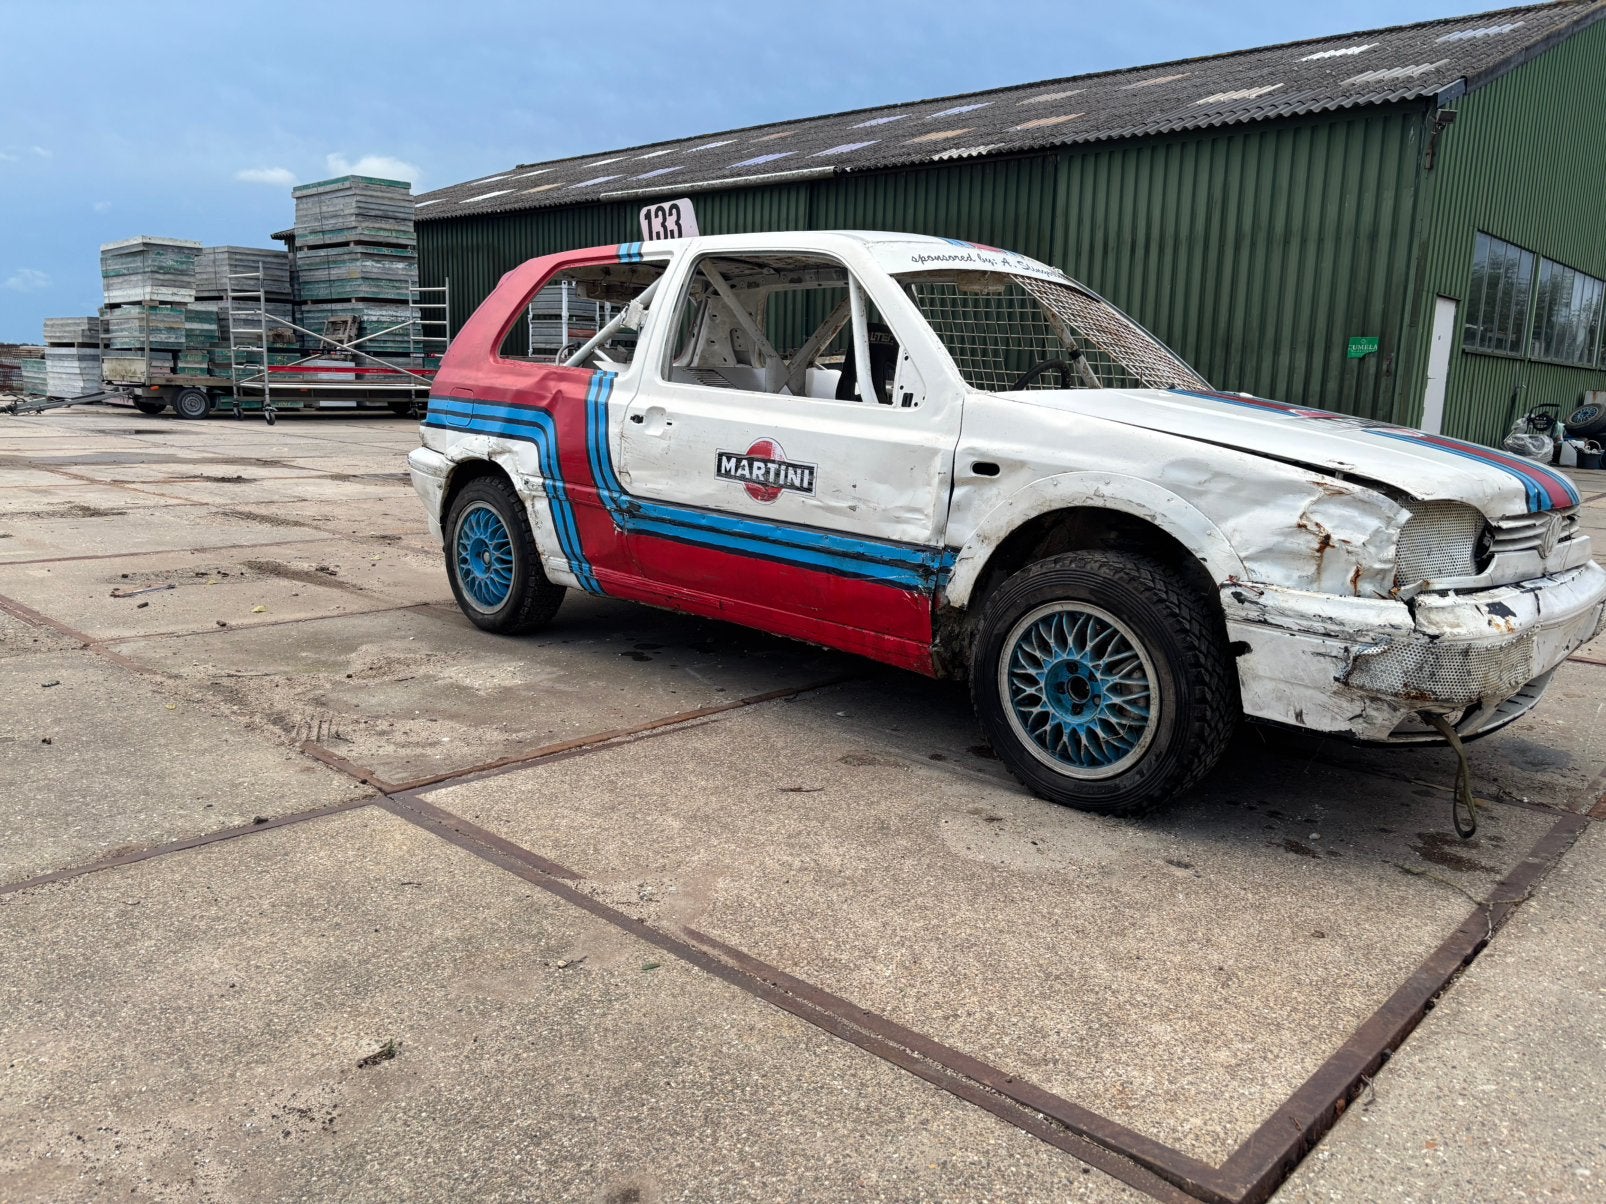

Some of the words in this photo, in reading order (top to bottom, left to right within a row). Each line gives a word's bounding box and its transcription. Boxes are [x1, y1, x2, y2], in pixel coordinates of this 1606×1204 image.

[644, 203, 683, 241] 133
[911, 253, 975, 265] sponsored
[721, 455, 811, 489] MARTINI
